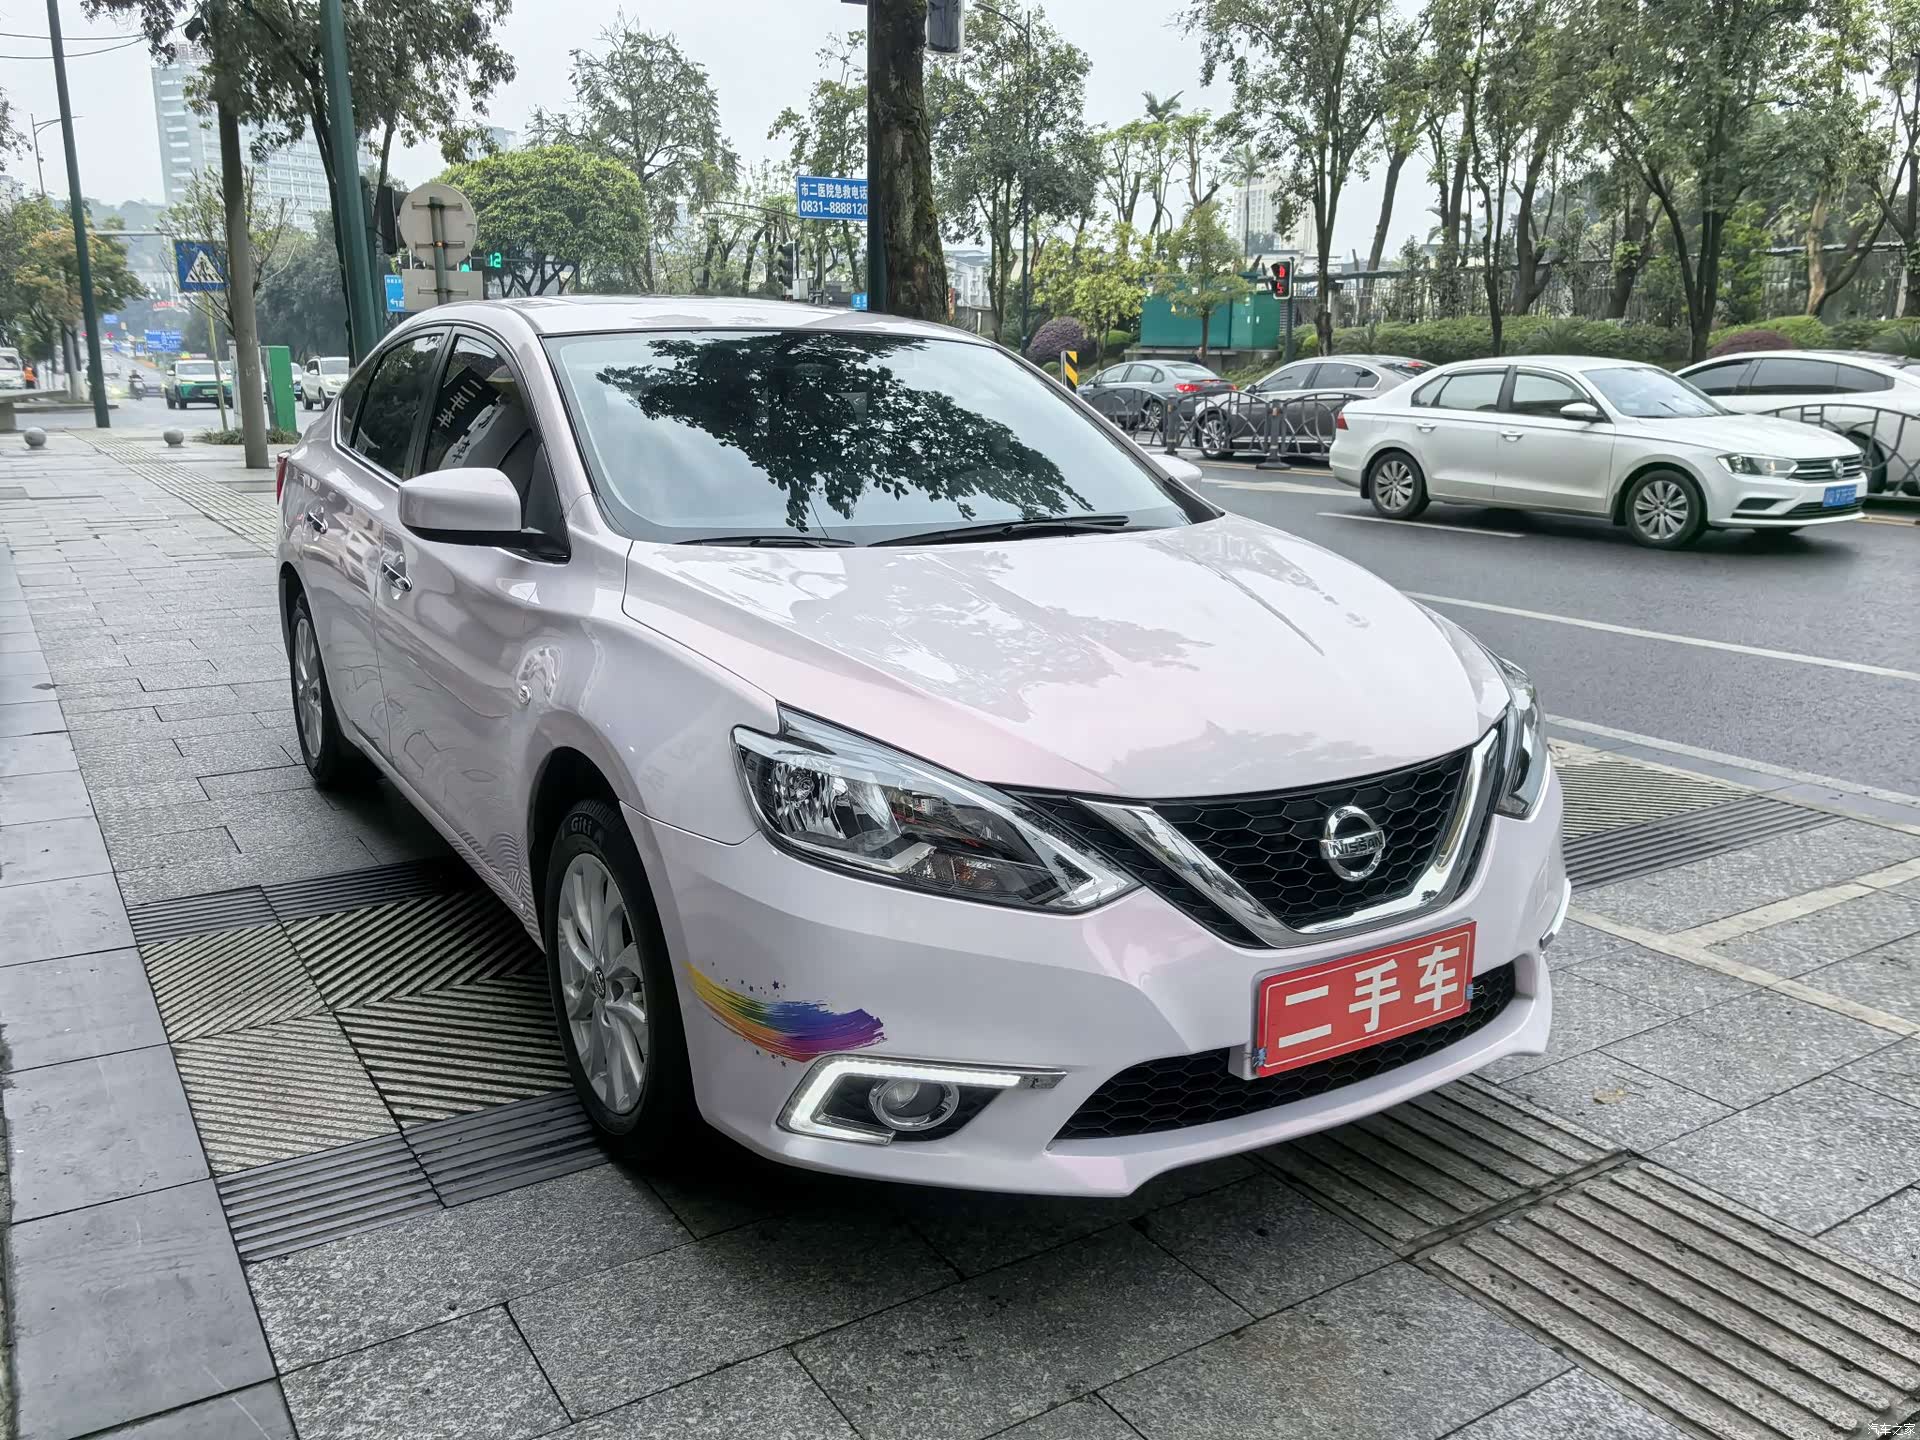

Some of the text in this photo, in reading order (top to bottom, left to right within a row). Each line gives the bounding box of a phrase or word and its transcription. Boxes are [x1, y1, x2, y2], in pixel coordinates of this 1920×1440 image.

[801, 183, 867, 199] 市二医院急救电话
[801, 200, 867, 215] 0831-8888120
[571, 817, 593, 835] Giti
[1332, 836, 1384, 856] NISSAN
[1278, 945, 1460, 1048] 二手车
